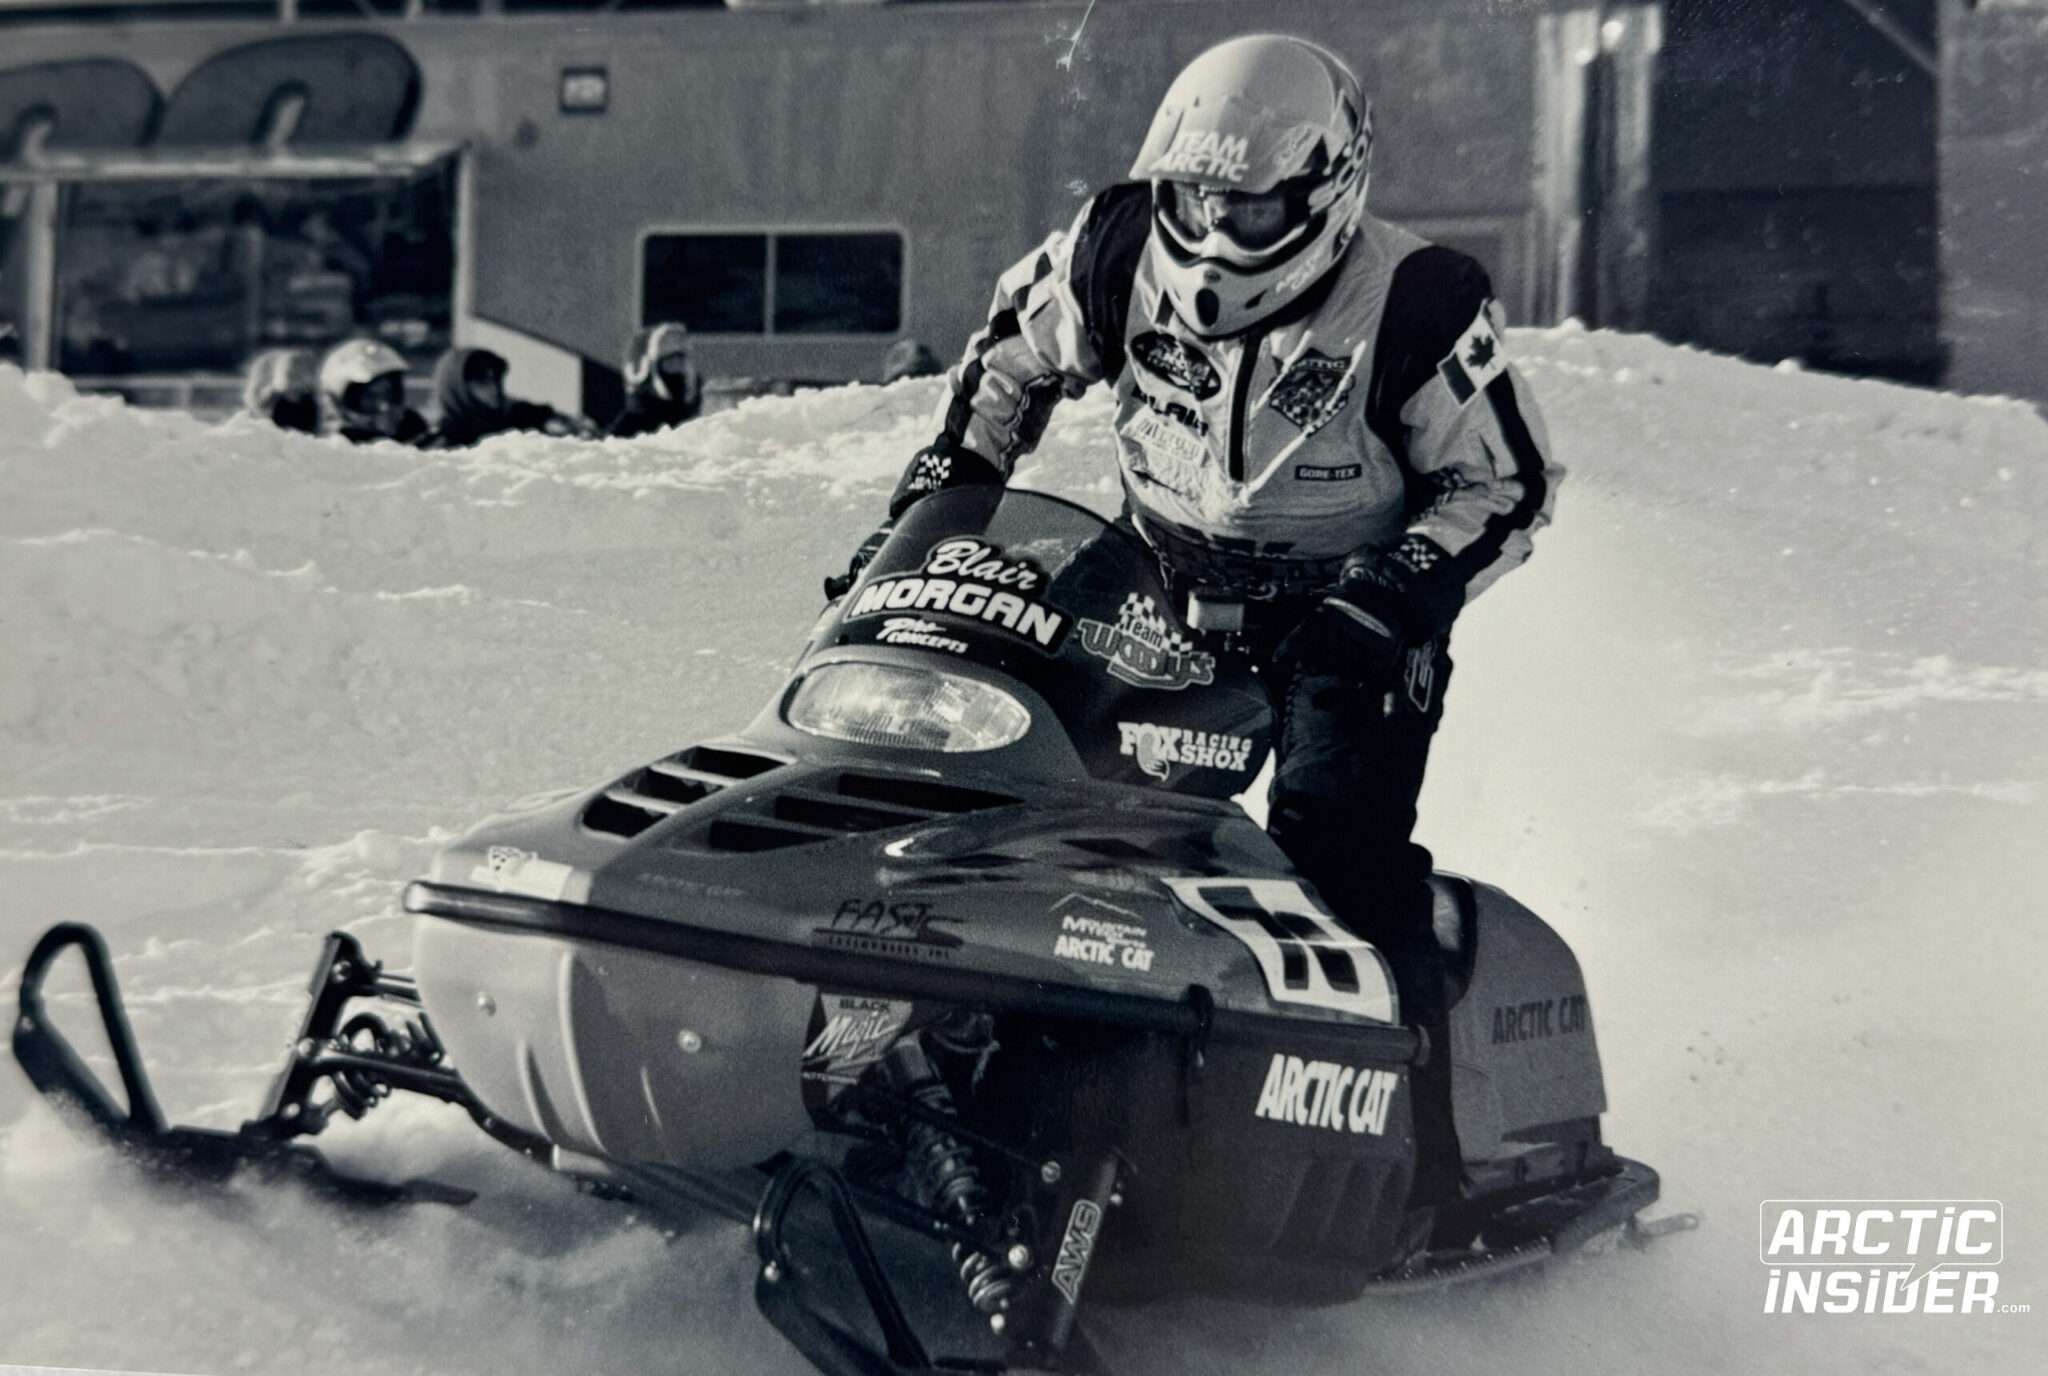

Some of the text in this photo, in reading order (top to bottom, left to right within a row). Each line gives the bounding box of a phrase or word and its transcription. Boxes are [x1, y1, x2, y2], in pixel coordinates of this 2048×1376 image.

[1148, 152, 1249, 182] ARCTIC
[1177, 131, 1249, 161] TEAM
[927, 540, 1039, 590] Blair
[851, 578, 1062, 646] MORGAN
[1122, 614, 1163, 650] Team
[1117, 721, 1182, 777] FOX
[1179, 744, 1250, 772] SHOX
[1181, 729, 1253, 752] RACING
[1054, 934, 1116, 966] ARCTIC
[1121, 946, 1155, 972] CAT
[839, 999, 891, 1012] BLACK
[1491, 994, 1586, 1045] ARCTIC CAT
[802, 1010, 900, 1059] Magic
[1254, 1052, 1399, 1136] ARCTIC CAT
[1053, 1203, 1099, 1301] AWS
